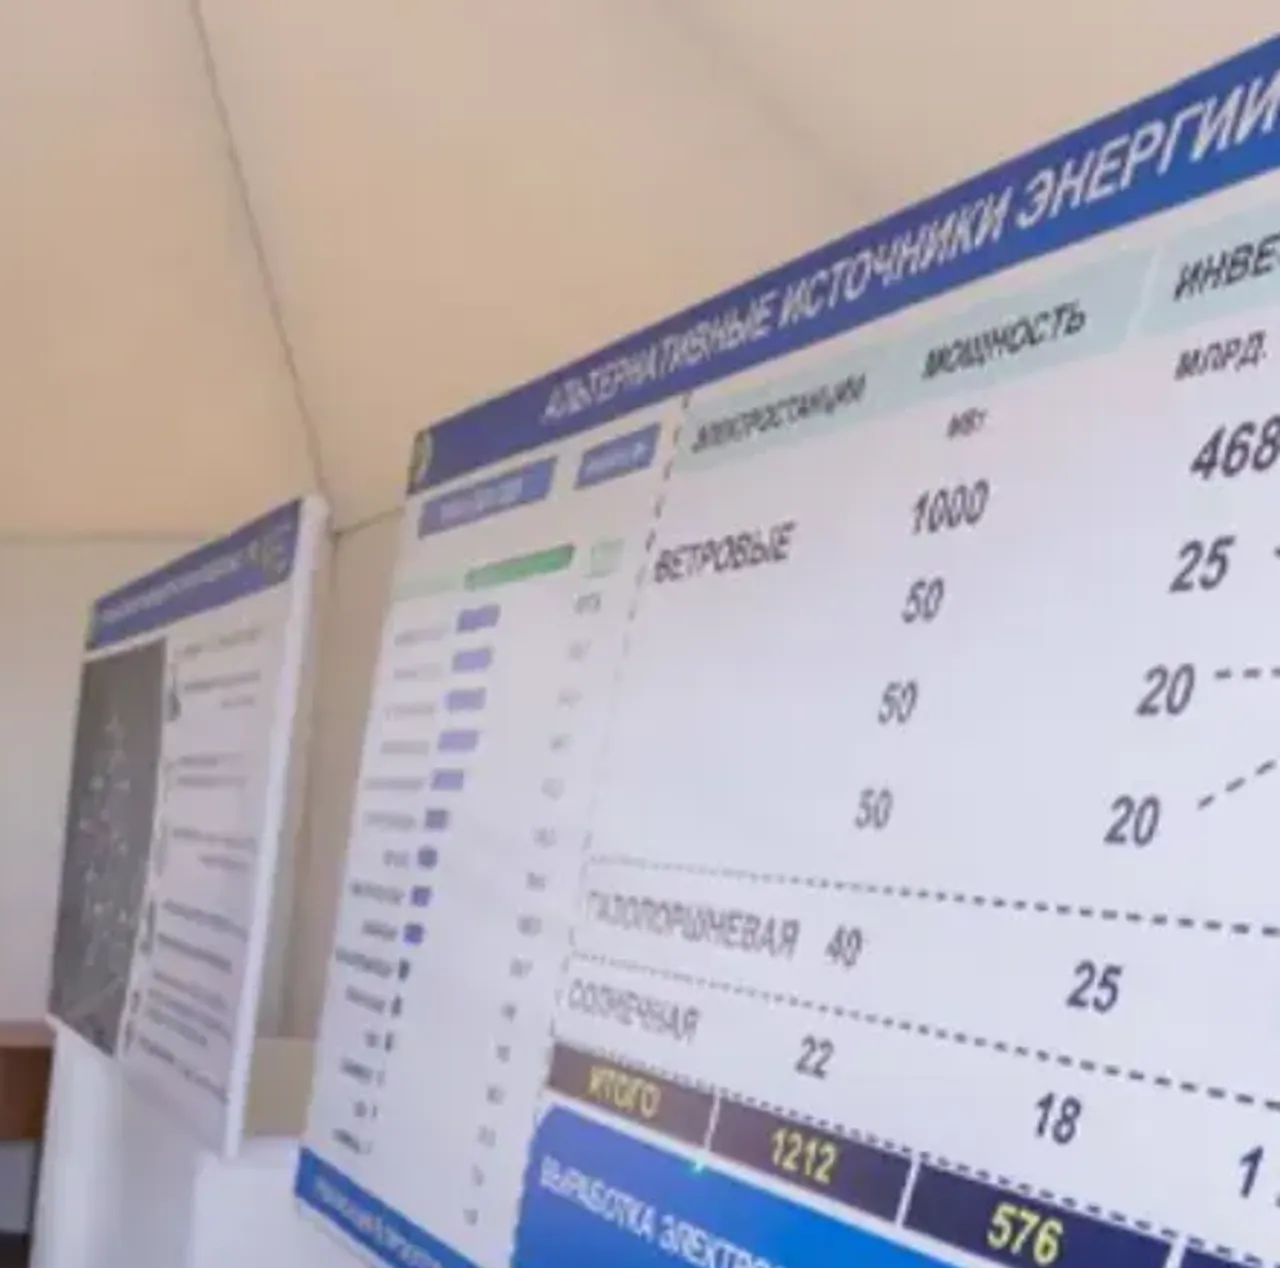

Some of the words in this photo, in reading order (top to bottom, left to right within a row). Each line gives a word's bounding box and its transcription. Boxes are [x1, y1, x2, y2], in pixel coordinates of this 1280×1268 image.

[778, 186, 1013, 330] ИСТОЧНИКИ
[1016, 68, 1280, 230] ЭНЕРГИИ
[922, 300, 1086, 379] МОЩНОСТЬ
[654, 521, 797, 584] ВЕТРОВЫЕ
[911, 479, 990, 535] 1000
[1189, 414, 1280, 480] 468
[901, 577, 945, 624] 50
[1169, 534, 1235, 593] 25
[878, 680, 918, 725] 50
[1136, 663, 1195, 717] 20
[855, 787, 894, 830] 50
[1103, 795, 1162, 847] 20
[825, 924, 864, 970] 40
[1066, 959, 1123, 1014] 25
[794, 1035, 835, 1079] 22
[1035, 1092, 1082, 1145] 18
[540, 1156, 657, 1244] ВЫРАБОТКА
[771, 1127, 838, 1186] 1212
[987, 1203, 1065, 1266] 576
